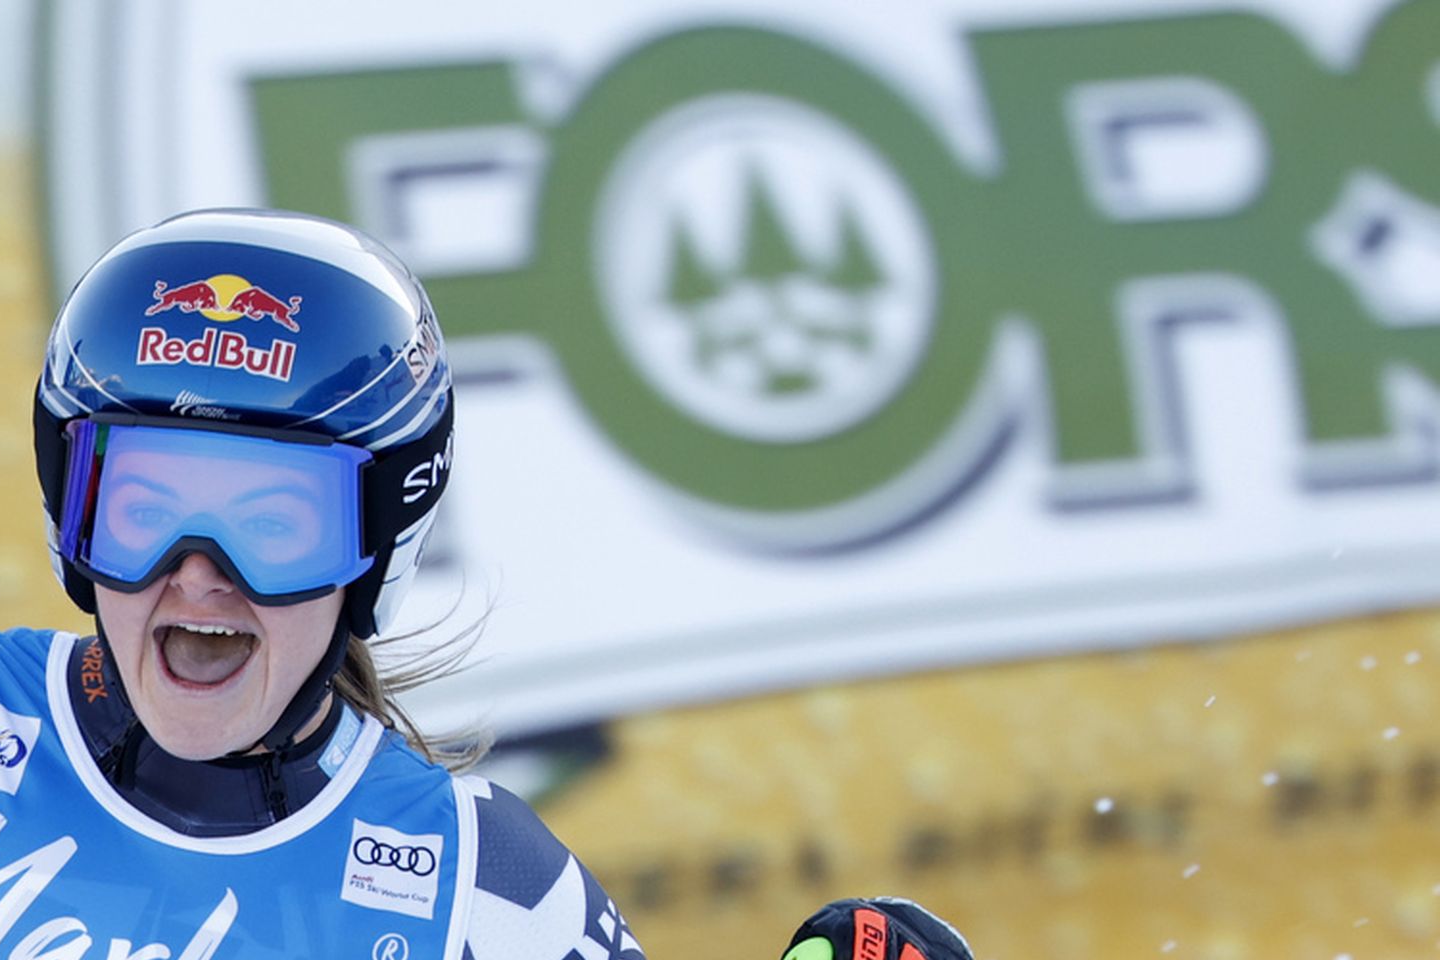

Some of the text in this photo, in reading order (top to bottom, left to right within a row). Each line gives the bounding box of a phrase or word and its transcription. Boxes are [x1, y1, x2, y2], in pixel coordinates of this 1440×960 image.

[136, 328, 297, 383] Red Bull
[402, 430, 455, 504] SM
